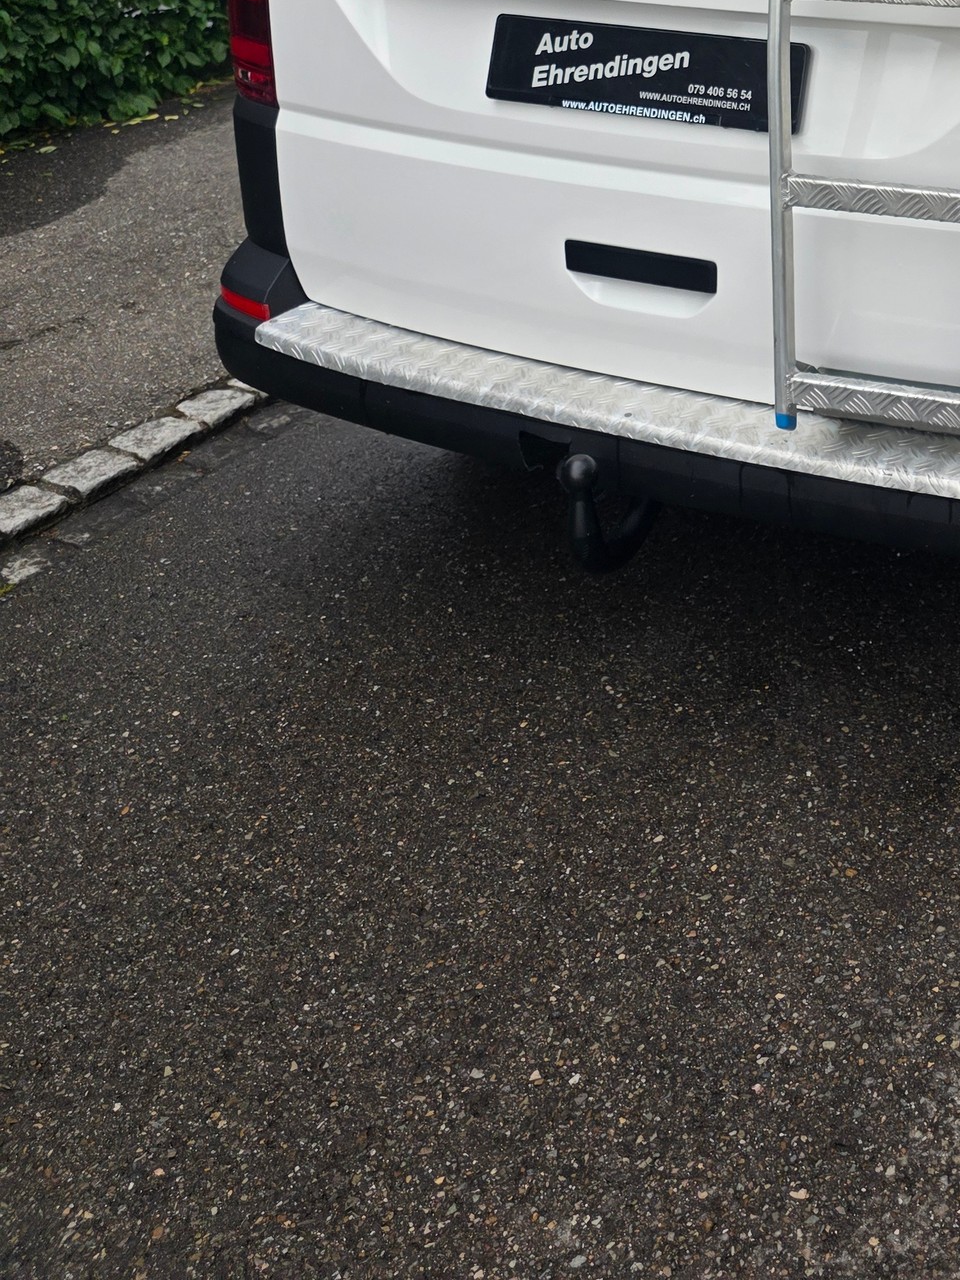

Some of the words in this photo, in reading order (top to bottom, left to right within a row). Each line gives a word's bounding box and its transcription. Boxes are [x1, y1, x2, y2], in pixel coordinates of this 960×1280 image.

[535, 29, 594, 55] Auto
[531, 50, 690, 88] Ehrendingen
[639, 91, 751, 111] WWW.AUTOEHRENDINGEN.CH
[687, 83, 705, 95] 079
[706, 86, 725, 97] 406
[726, 88, 739, 99] 56
[740, 90, 752, 100] 54
[561, 99, 706, 124] www.AUTOEHRENDINGEN.ch
